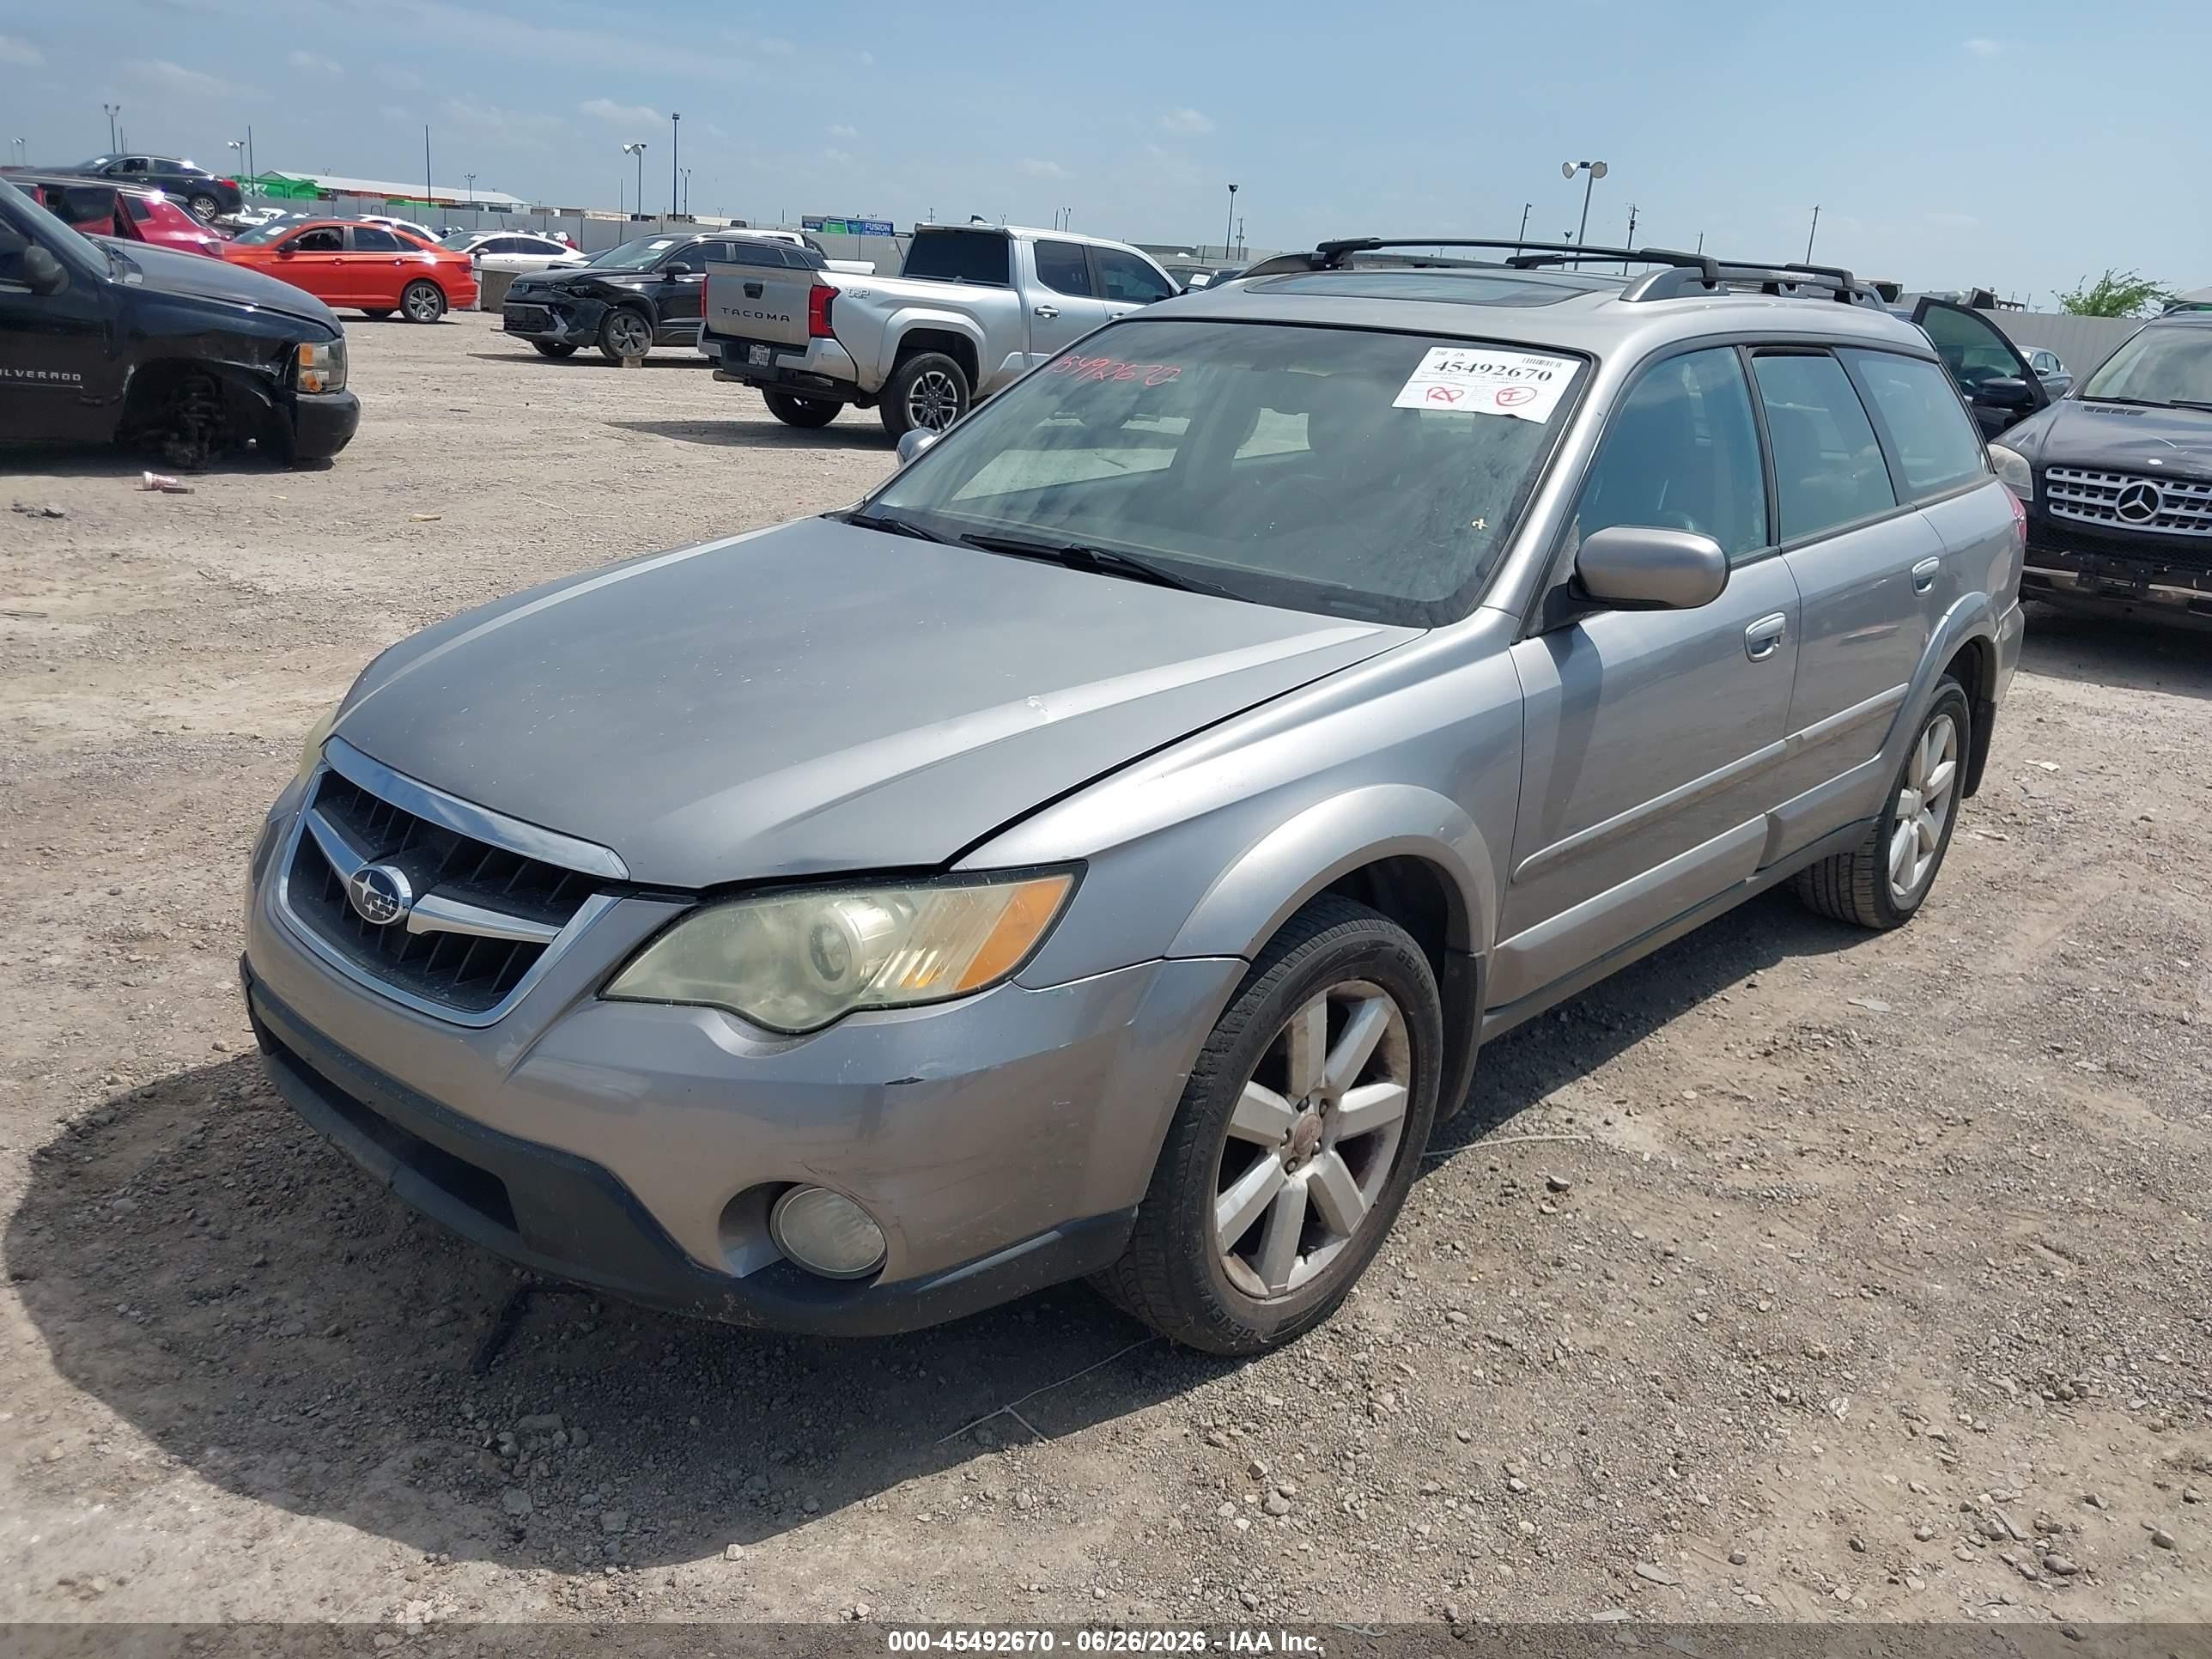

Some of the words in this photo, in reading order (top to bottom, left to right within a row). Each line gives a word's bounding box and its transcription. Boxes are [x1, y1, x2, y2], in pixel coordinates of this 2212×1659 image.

[866, 222, 890, 232] FUSION
[721, 307, 790, 322] TACOMA
[1433, 361, 1553, 382] 45492670
